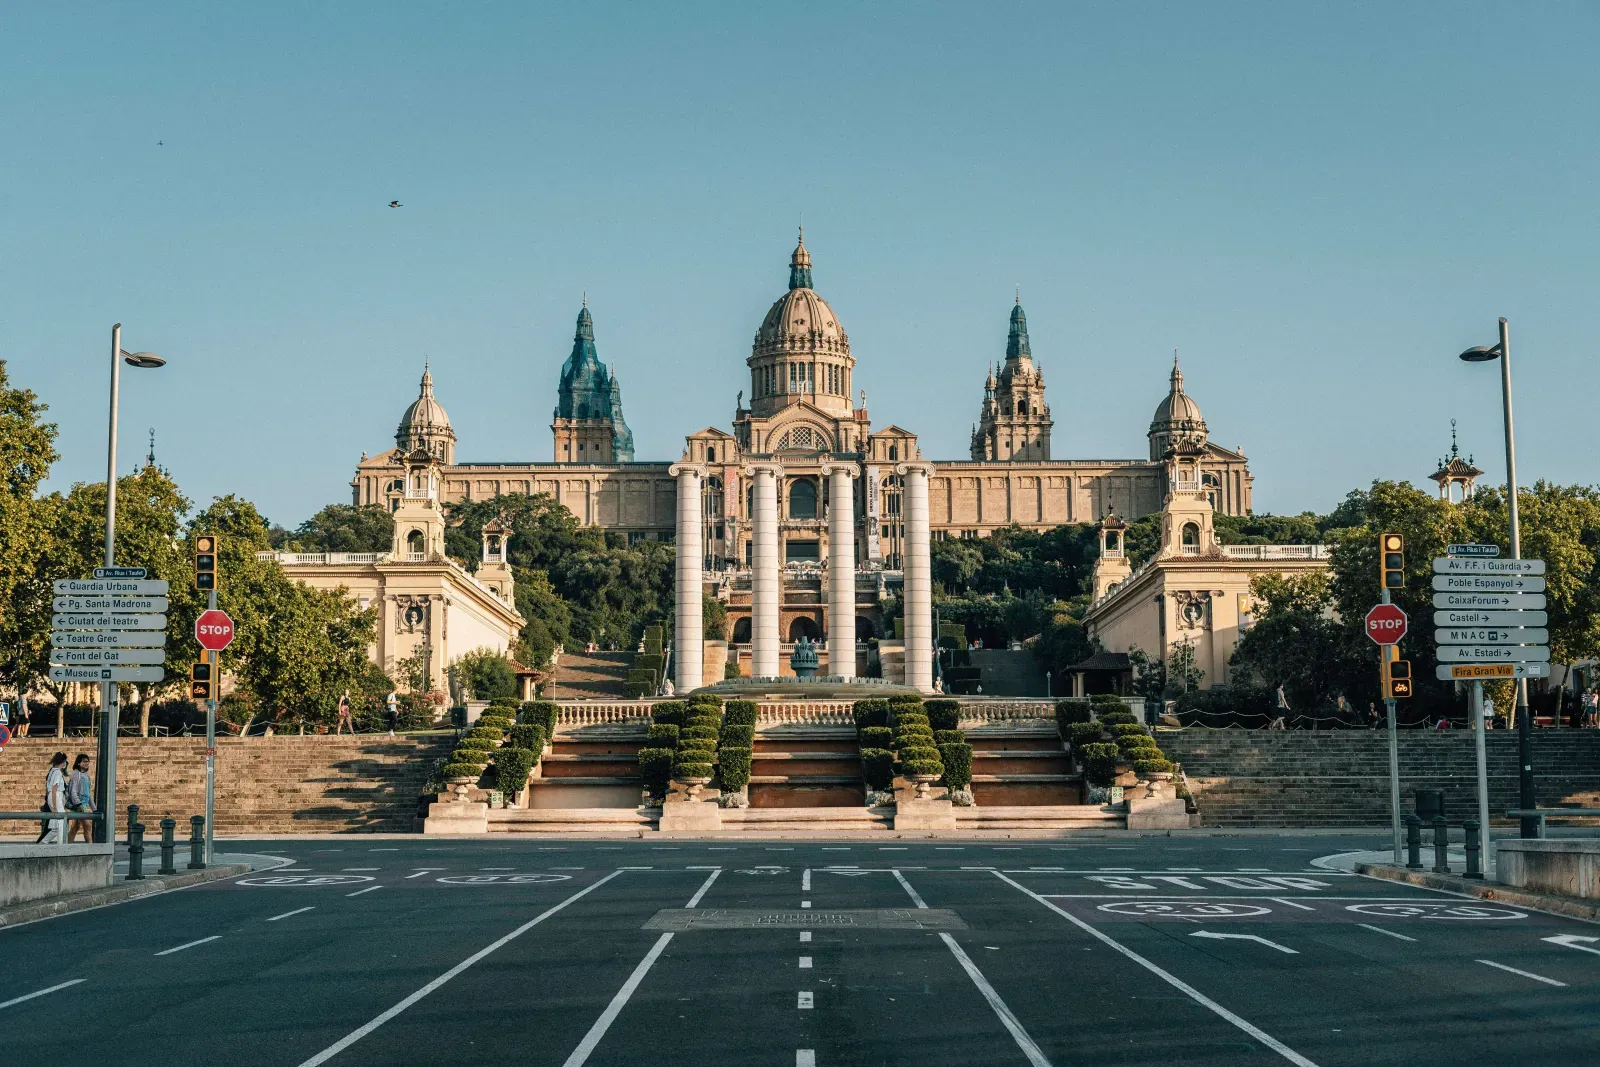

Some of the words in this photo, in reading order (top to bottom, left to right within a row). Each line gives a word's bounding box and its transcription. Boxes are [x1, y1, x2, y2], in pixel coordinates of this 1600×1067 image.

[70, 582, 103, 590] Guardia
[107, 582, 138, 591] Urbana
[1475, 580, 1513, 589] Espanyol
[69, 600, 82, 609] Pg.
[1370, 620, 1403, 630] STOP
[200, 625, 230, 635] STOP
[1455, 668, 1471, 676] Fira
[1475, 667, 1494, 676] Gran
[1083, 876, 1332, 890] STOP
